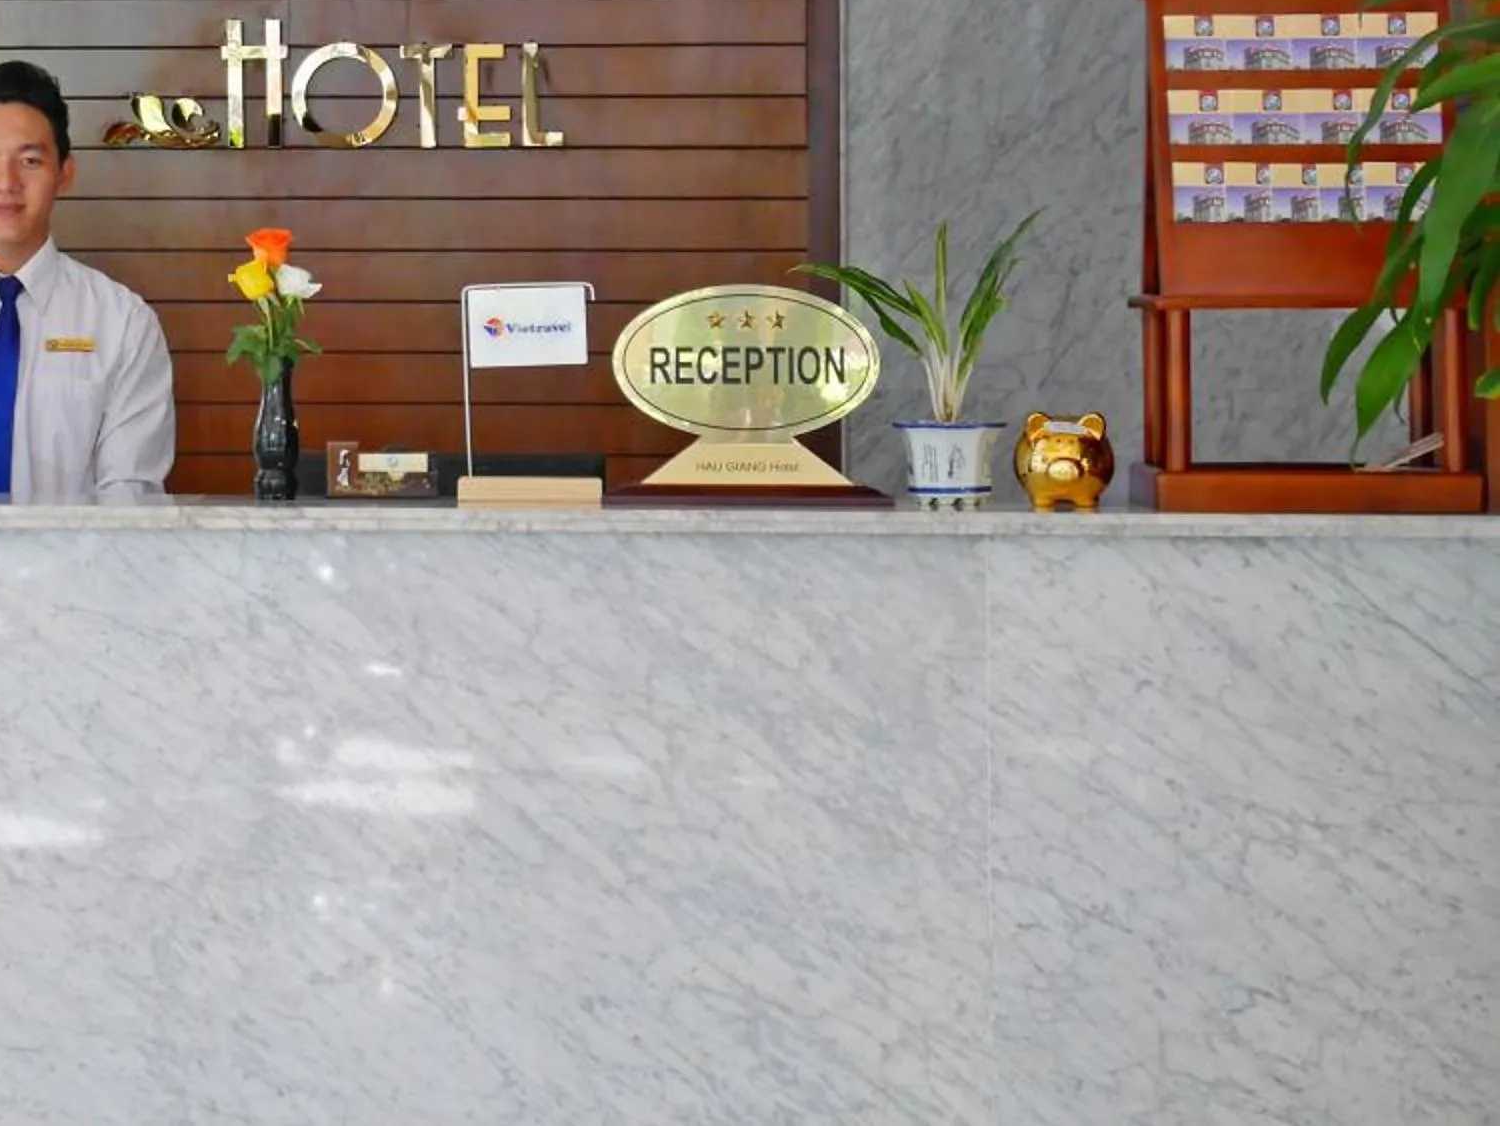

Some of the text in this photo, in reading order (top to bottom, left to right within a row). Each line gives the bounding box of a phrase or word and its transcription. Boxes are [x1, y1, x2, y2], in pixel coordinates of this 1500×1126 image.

[505, 321, 572, 334] Vietravel
[649, 346, 846, 385] RECEPTION
[725, 461, 767, 473] GIANG
